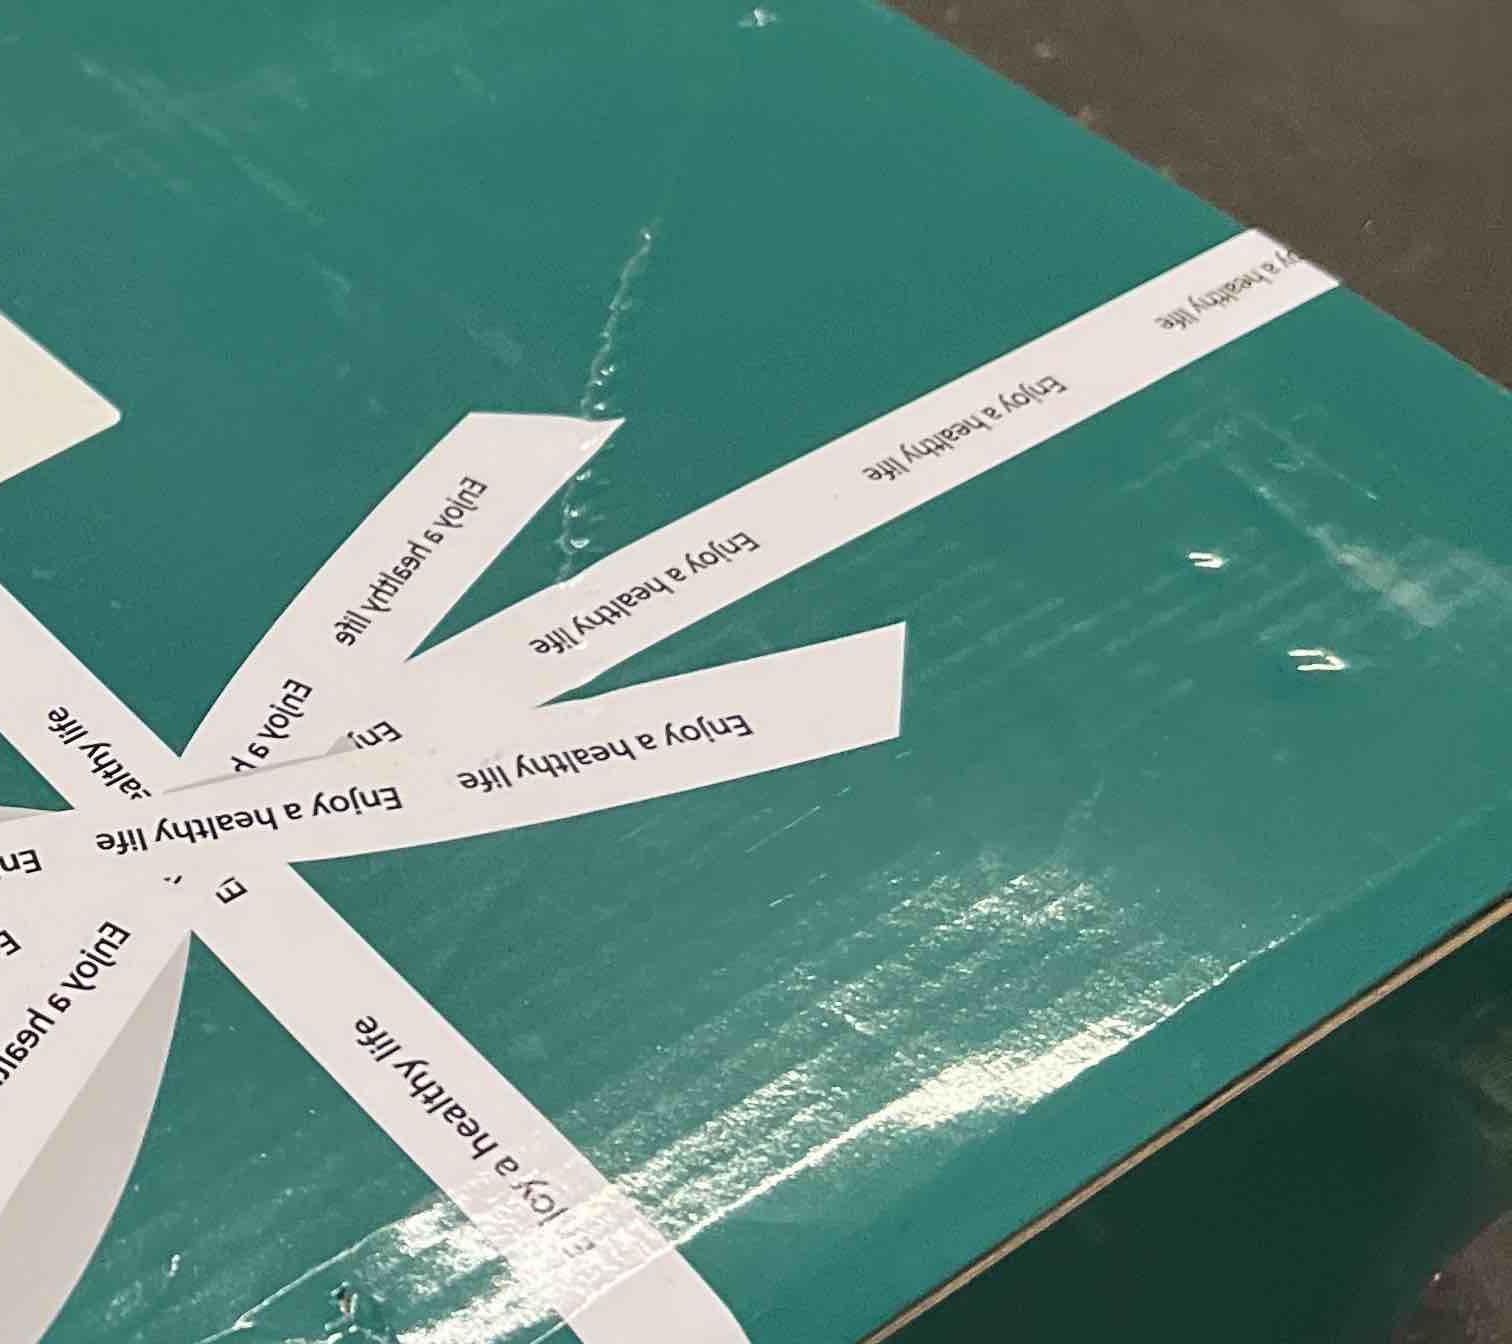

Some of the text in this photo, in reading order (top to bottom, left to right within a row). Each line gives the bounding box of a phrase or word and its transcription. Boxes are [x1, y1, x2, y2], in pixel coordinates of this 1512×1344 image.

[862, 375, 1067, 481] Enjoy a healthy life
[528, 532, 760, 654] Enjoy a healthy life
[48, 707, 88, 745] life
[457, 715, 754, 792] Enjoy a healthy life
[96, 786, 403, 855] Enjoy a healthy life
[354, 1016, 403, 1063] life
[392, 1059, 499, 1160] healthy
[494, 1155, 519, 1176] a
